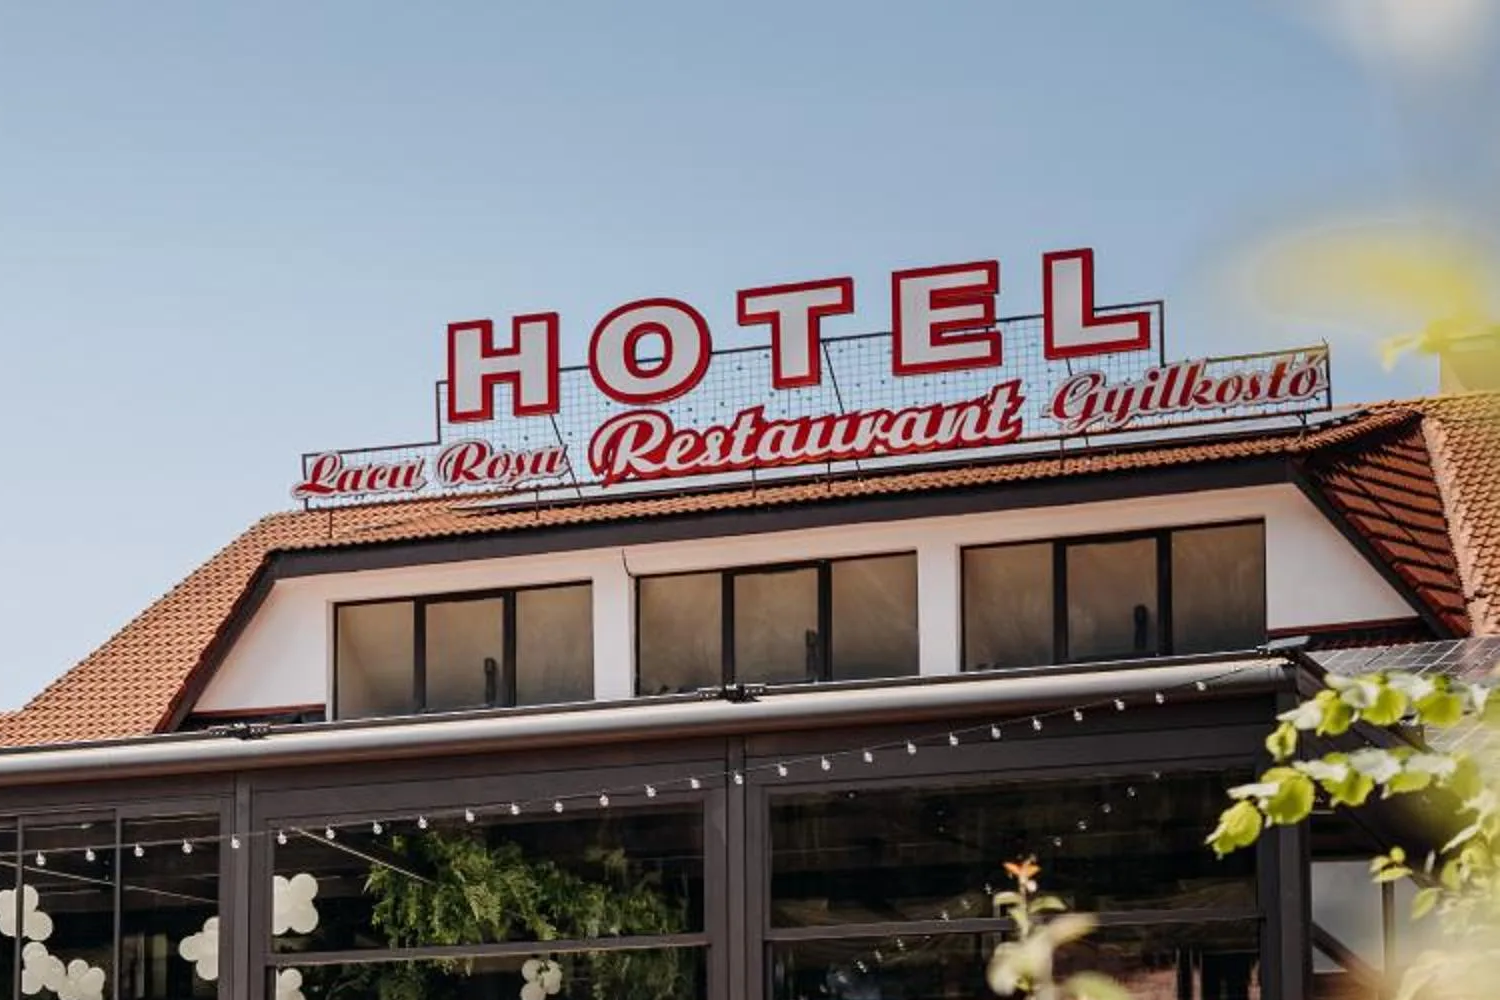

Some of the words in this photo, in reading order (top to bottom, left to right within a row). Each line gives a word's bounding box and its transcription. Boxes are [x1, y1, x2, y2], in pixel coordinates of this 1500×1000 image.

[447, 247, 1151, 424] HOTEL
[292, 450, 427, 497] Lacu
[587, 379, 1026, 488] Restaurant
[1043, 350, 1328, 432] Gyilkostó
